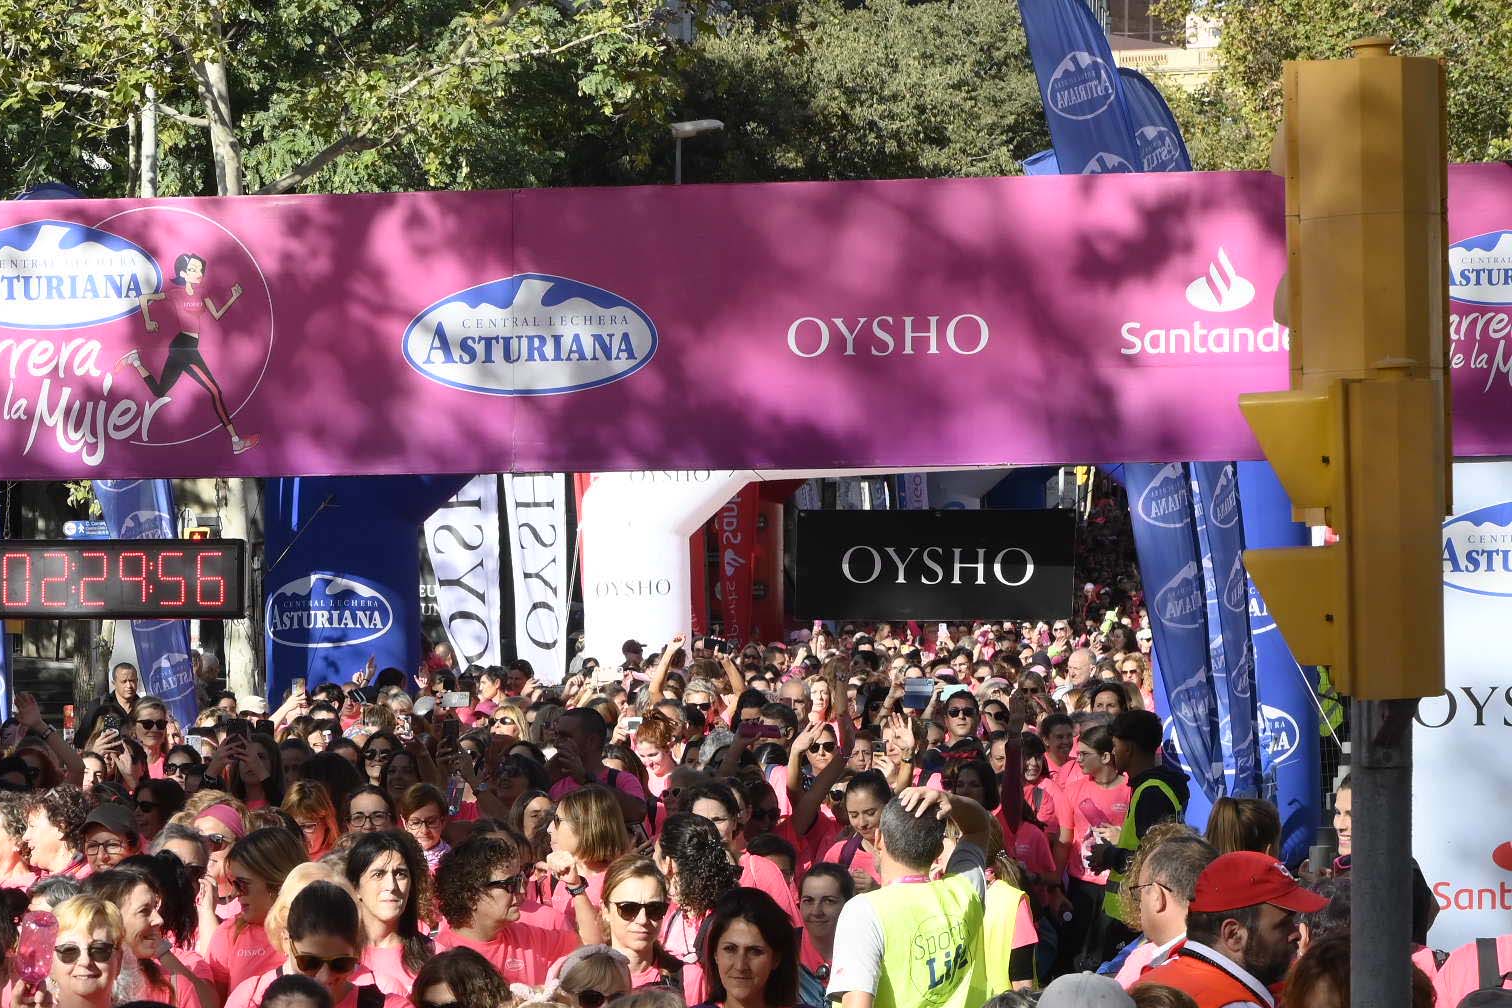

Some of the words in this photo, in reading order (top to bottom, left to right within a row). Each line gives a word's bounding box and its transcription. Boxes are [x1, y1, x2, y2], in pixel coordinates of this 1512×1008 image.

[461, 316, 542, 328] CENTRAL
[548, 313, 630, 326] LECHERA
[787, 314, 989, 358] OYSHO
[423, 320, 639, 367] ASTURIANA
[3, 382, 28, 421] la
[24, 373, 171, 466] Mujer
[2, 552, 225, 607] 02:29:56
[595, 578, 671, 597] OYSHO
[841, 545, 1035, 587] OYSHO
[272, 604, 383, 631] ASTURIANA
